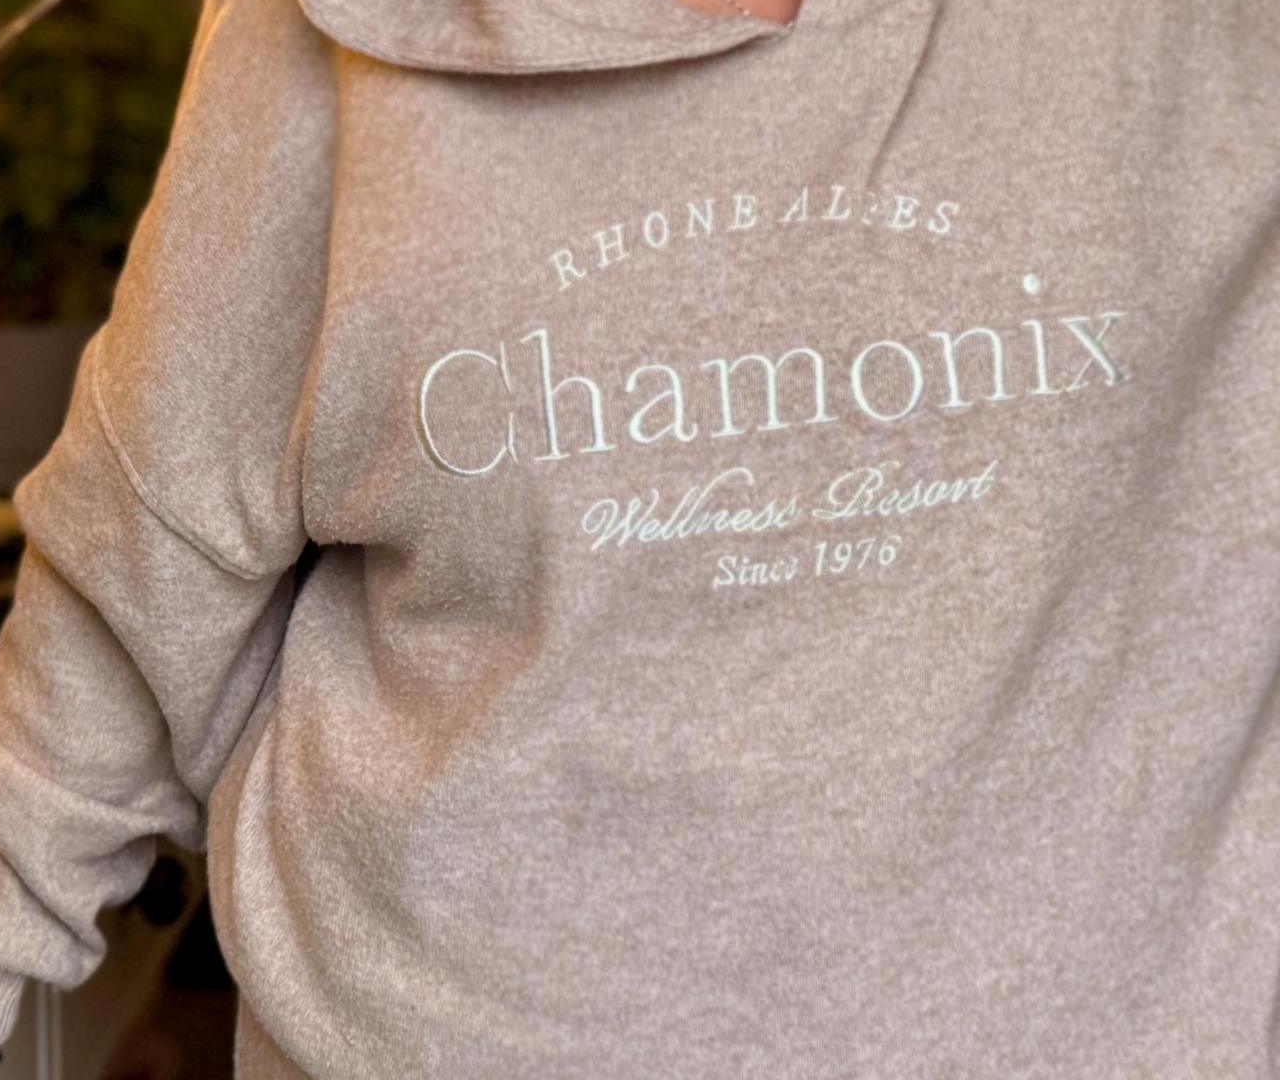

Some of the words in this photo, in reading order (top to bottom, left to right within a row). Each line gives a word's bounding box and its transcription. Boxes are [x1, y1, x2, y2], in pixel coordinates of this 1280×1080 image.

[548, 193, 757, 292] RHONE
[419, 272, 1133, 478] Chamonix
[581, 466, 803, 552] Wellness
[811, 459, 1000, 520] Resort
[713, 554, 799, 590] Since
[815, 534, 901, 577] 1976
